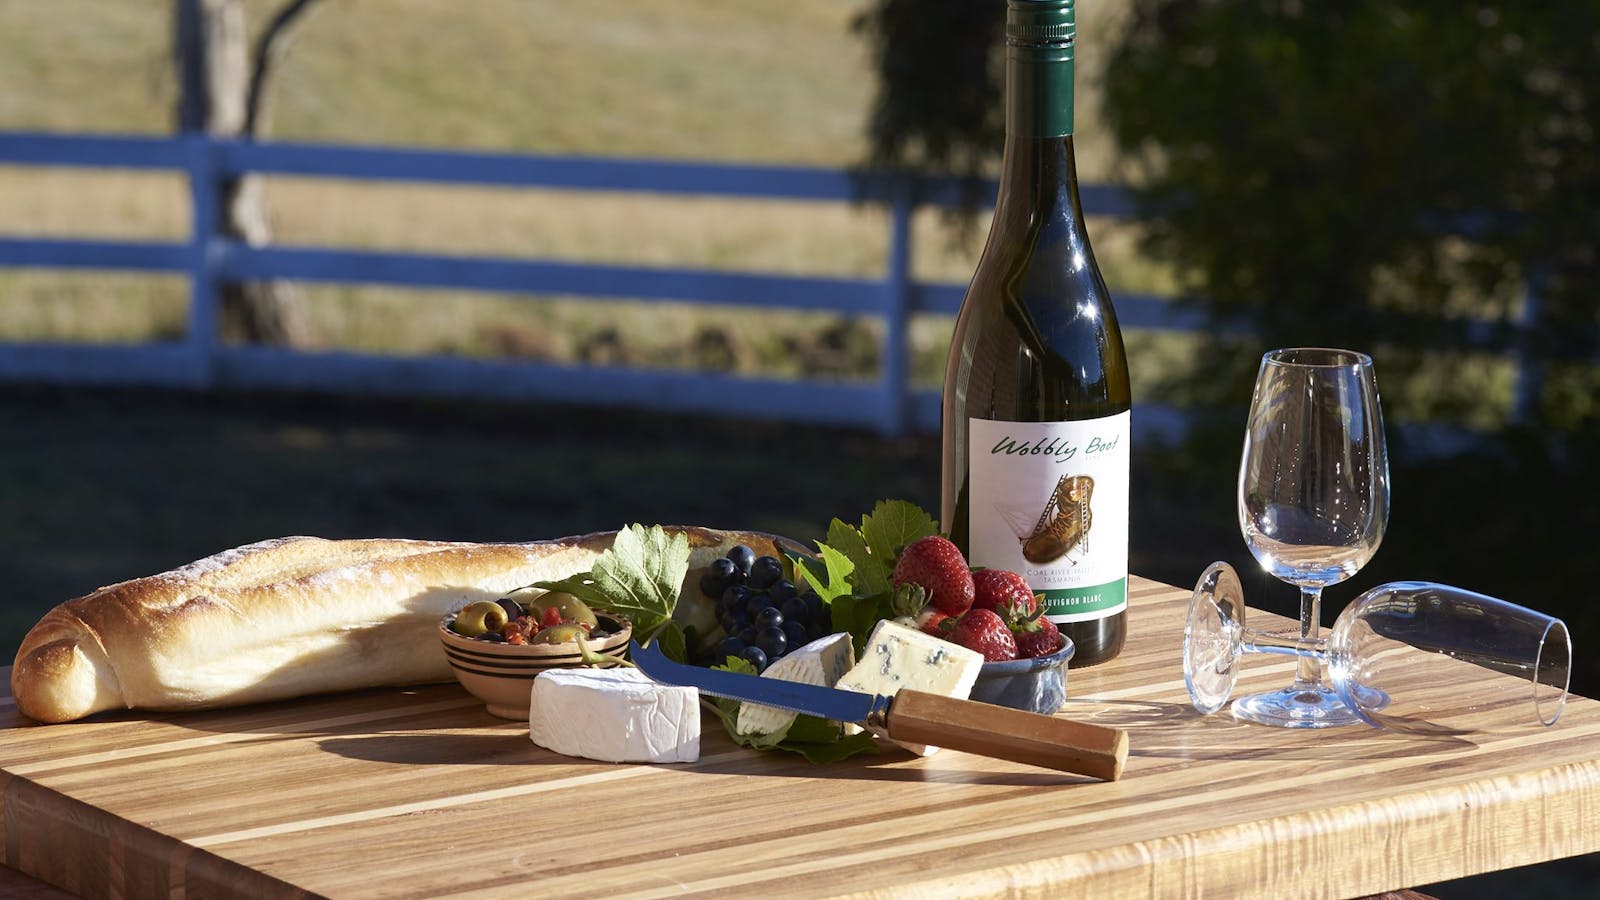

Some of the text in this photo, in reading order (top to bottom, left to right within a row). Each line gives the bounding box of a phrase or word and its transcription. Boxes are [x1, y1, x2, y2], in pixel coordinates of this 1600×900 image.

[991, 434, 1120, 463] Wobbly Boot
[1041, 594, 1102, 607] AUVIGNON BLANC
